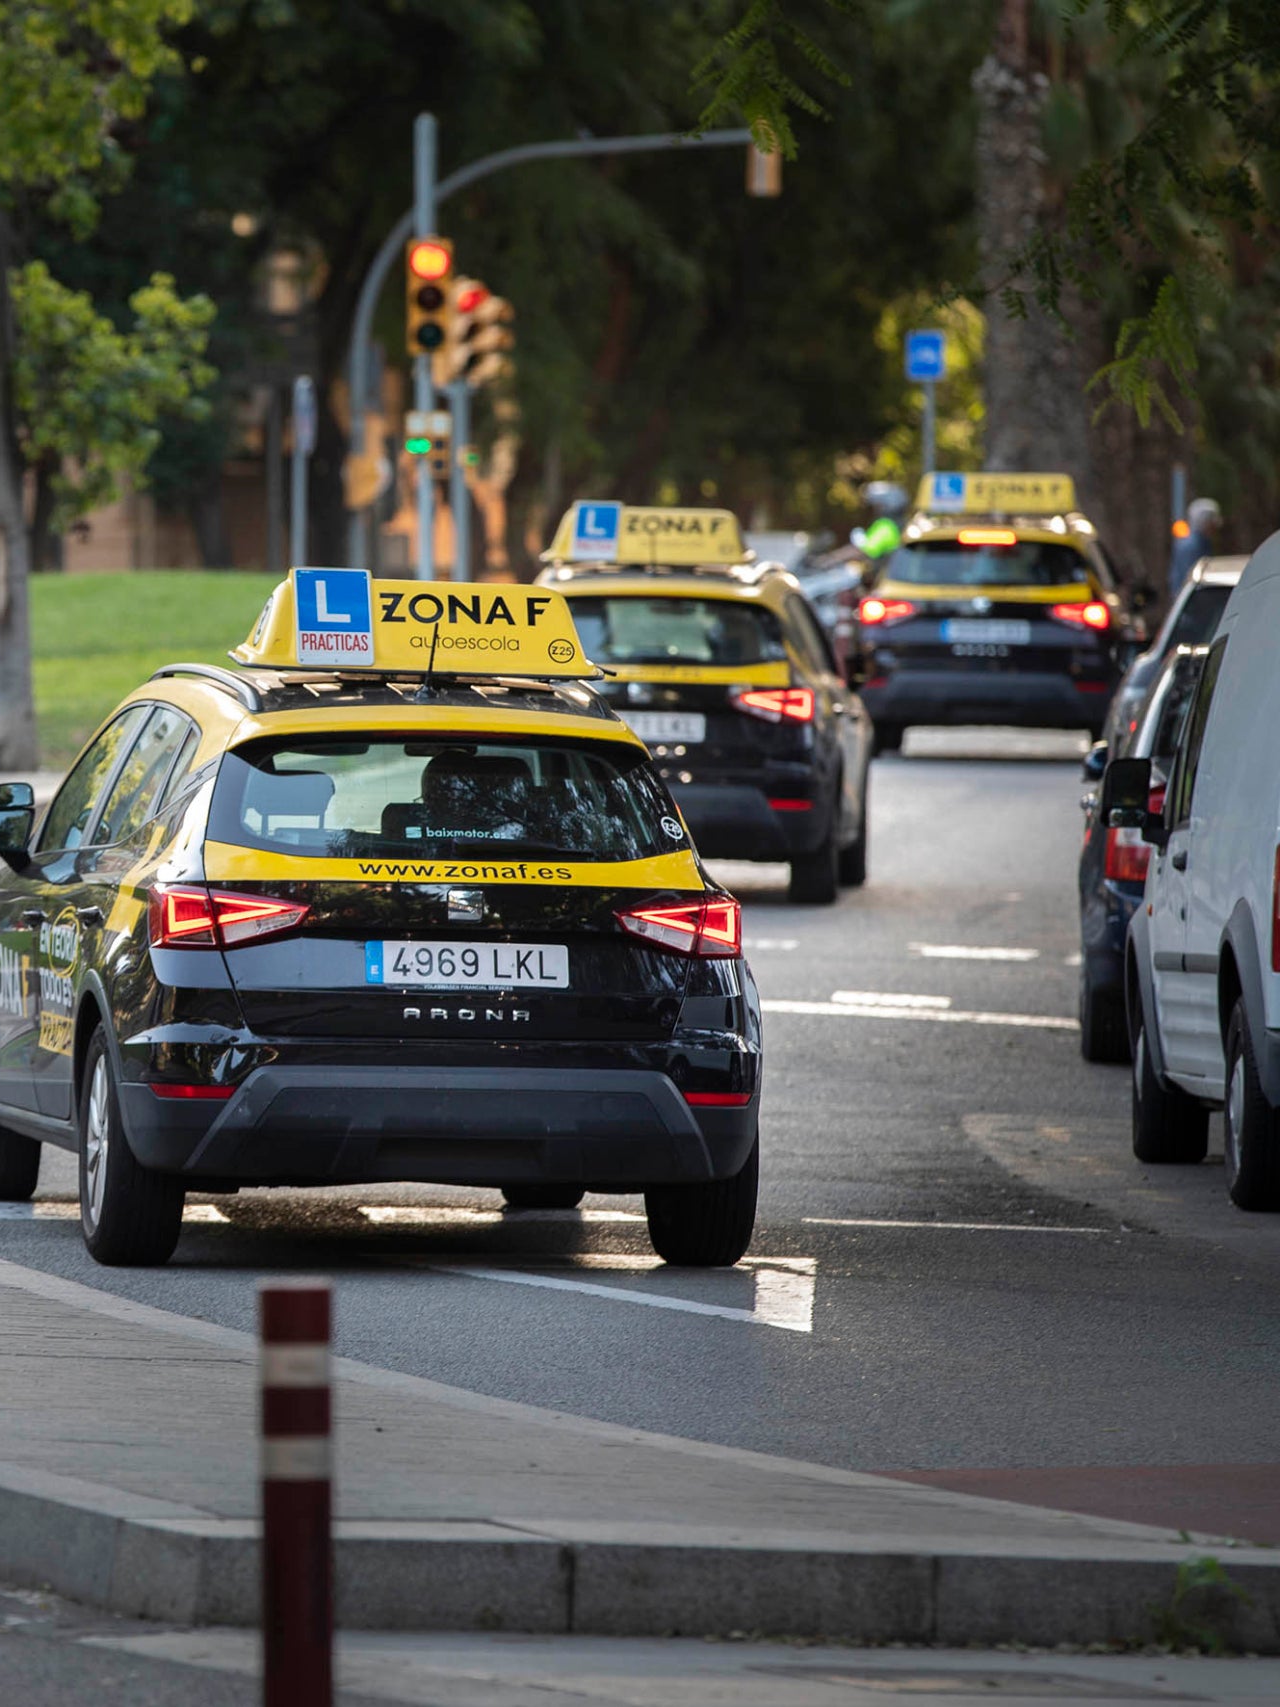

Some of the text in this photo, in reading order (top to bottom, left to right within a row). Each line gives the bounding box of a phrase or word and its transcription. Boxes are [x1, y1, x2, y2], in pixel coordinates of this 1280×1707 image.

[584, 509, 607, 535] L
[626, 515, 726, 535] ZONA F
[315, 580, 351, 623] L
[379, 592, 552, 626] ZONA F
[301, 632, 369, 652] PRACTICAS
[409, 634, 520, 651] autoescola
[551, 646, 572, 657] Z25
[359, 863, 572, 880] www.zonaf.es
[370, 965, 379, 975] E
[393, 947, 557, 980] 4969 LKL
[22, 954, 30, 1018] F
[39, 967, 62, 1004] TODO
[403, 1007, 530, 1021] ARONA
